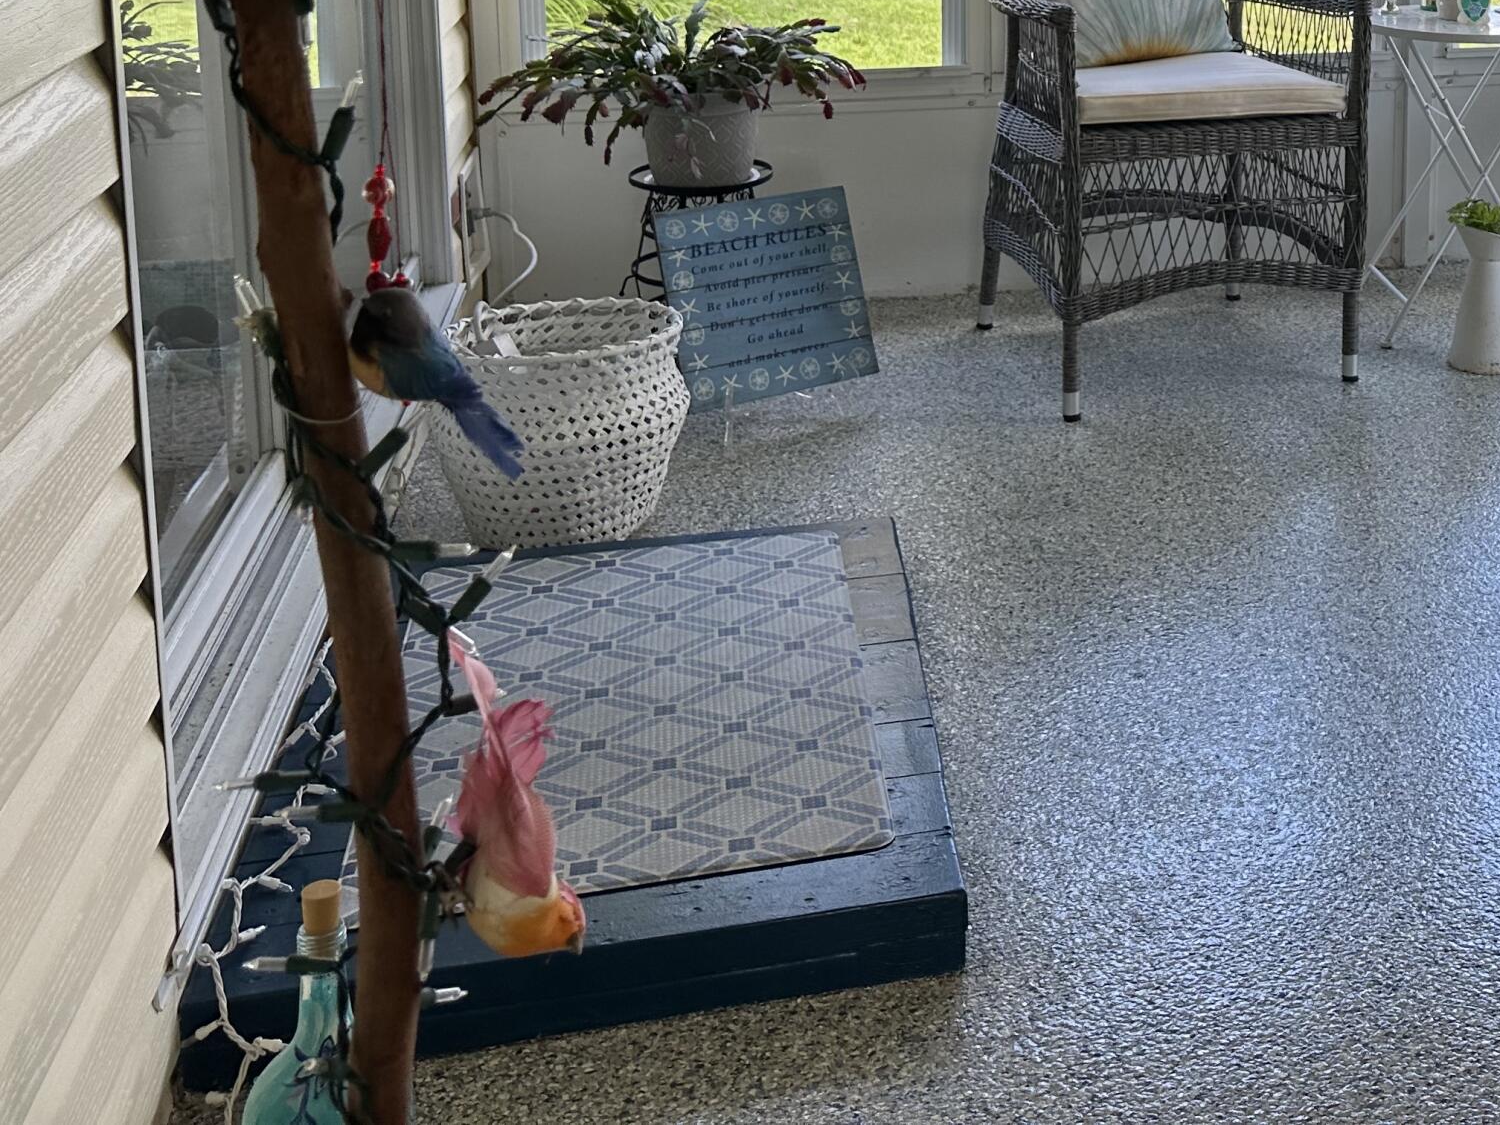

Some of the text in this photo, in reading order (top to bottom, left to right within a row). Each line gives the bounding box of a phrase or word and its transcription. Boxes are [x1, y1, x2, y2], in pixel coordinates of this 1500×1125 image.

[691, 223, 827, 259] BEACH RULES
[691, 262, 725, 275] Come
[729, 257, 748, 268] out
[753, 253, 764, 267] of
[768, 251, 795, 263] your
[704, 277, 739, 293] Avoid
[744, 274, 767, 289] pier
[707, 301, 721, 312] Be
[726, 295, 758, 308] shore
[762, 290, 774, 304] of
[710, 316, 745, 331] Don't
[748, 313, 766, 326] get
[771, 307, 794, 319] tide
[747, 323, 804, 344] Go ahead
[729, 355, 751, 367] and
[756, 348, 786, 363] make
